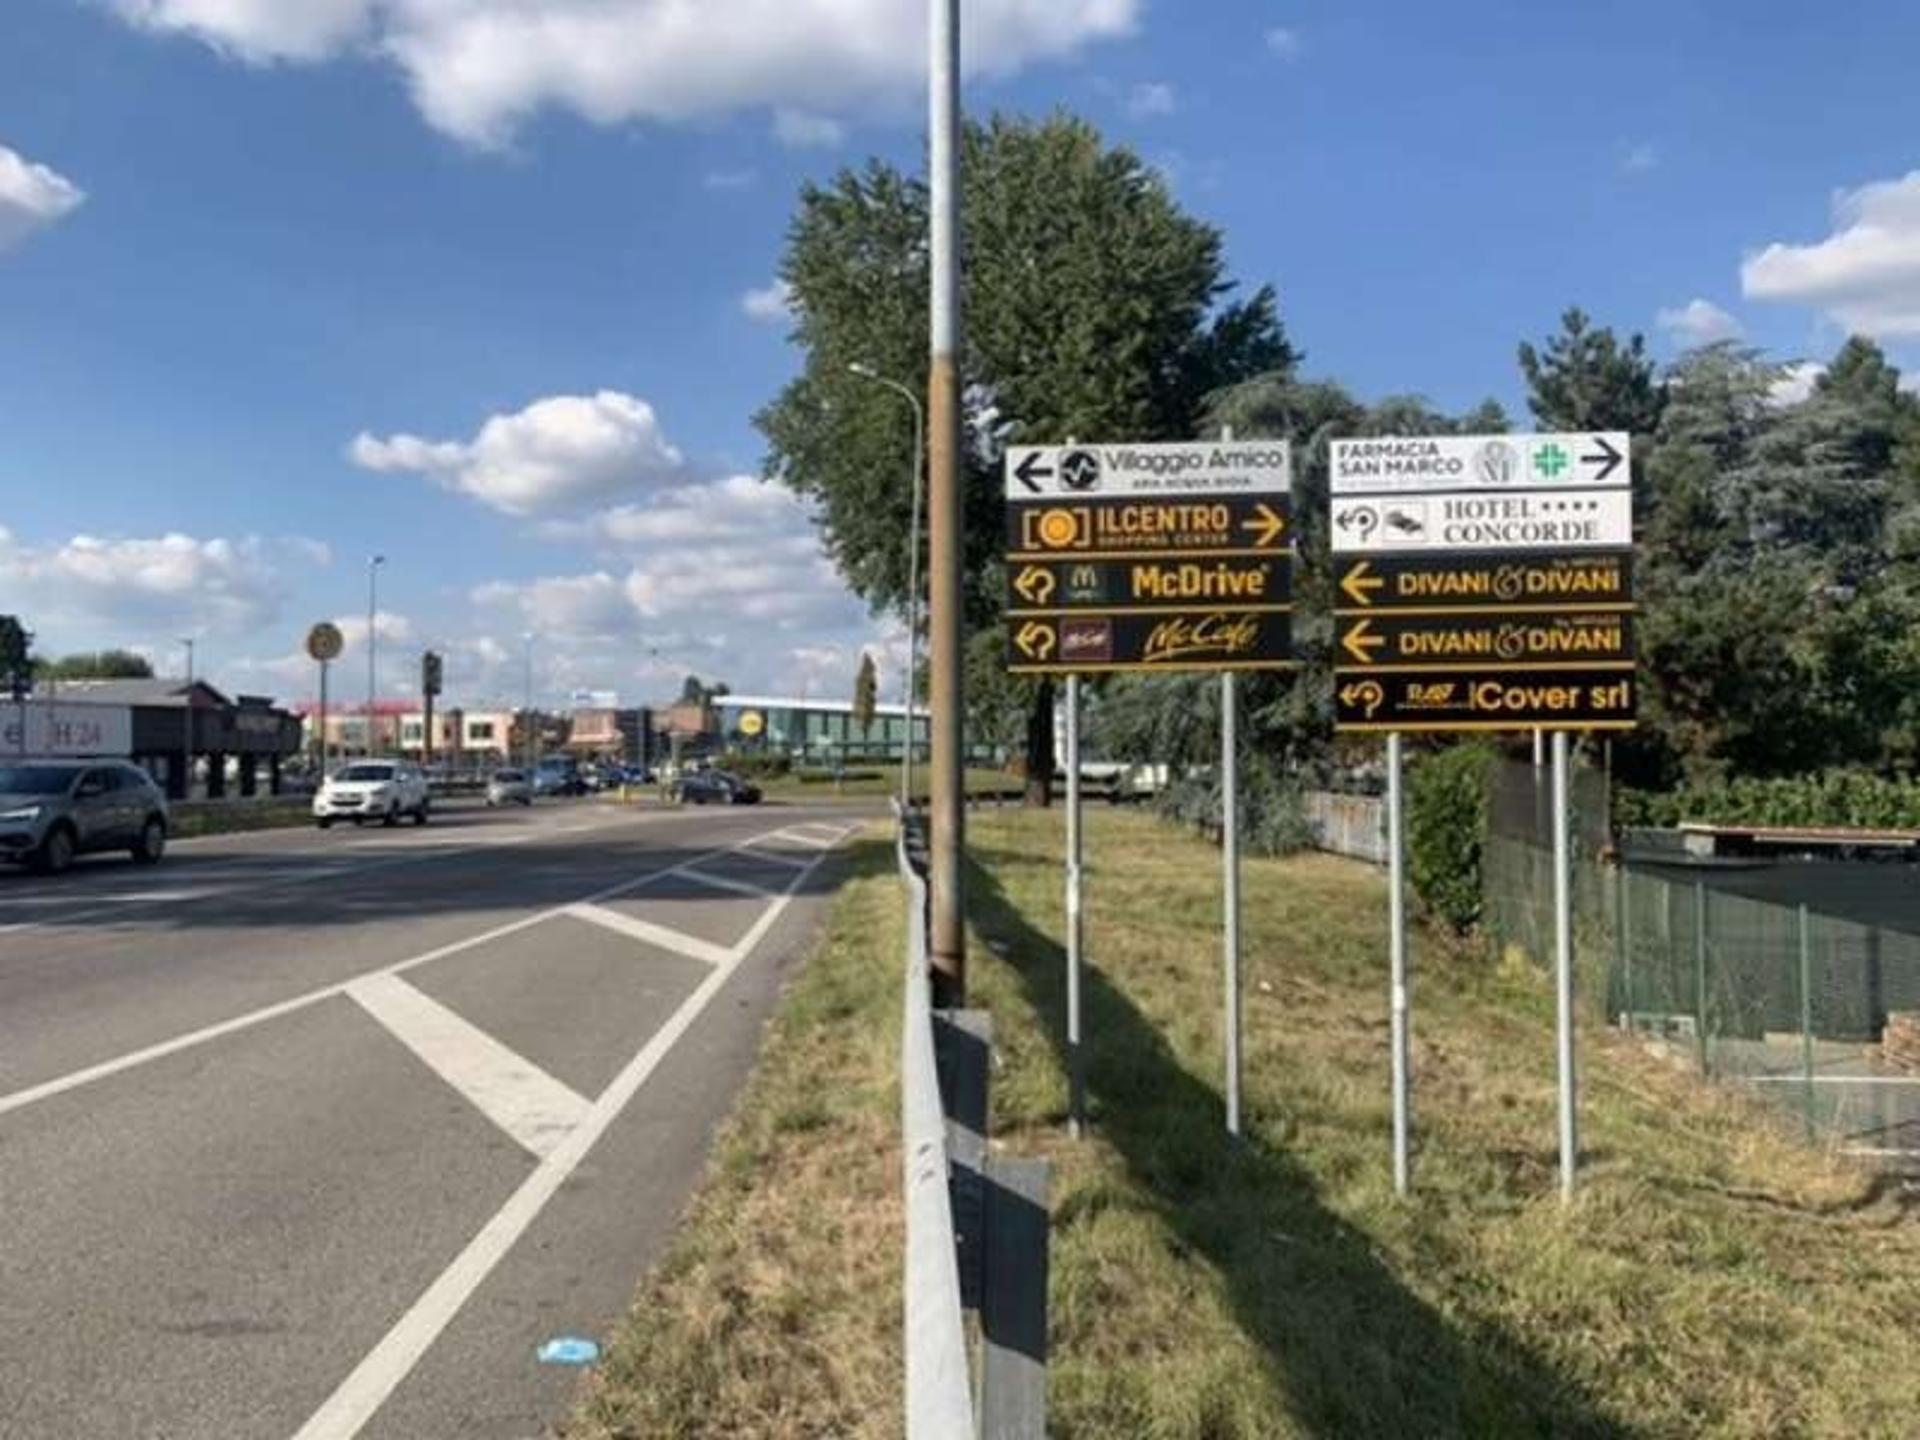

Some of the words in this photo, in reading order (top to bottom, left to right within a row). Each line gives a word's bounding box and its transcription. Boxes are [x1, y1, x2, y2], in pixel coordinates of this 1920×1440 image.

[1338, 442, 1439, 458] FARMACIA
[1105, 450, 1203, 474] Villaggio
[1209, 449, 1283, 469] Amico
[1338, 460, 1380, 476] SAN
[1386, 458, 1463, 475] MARCO
[1444, 500, 1535, 519] HOTEL
[1444, 520, 1598, 543] CONCORDE
[1590, 680, 1630, 709] srl
